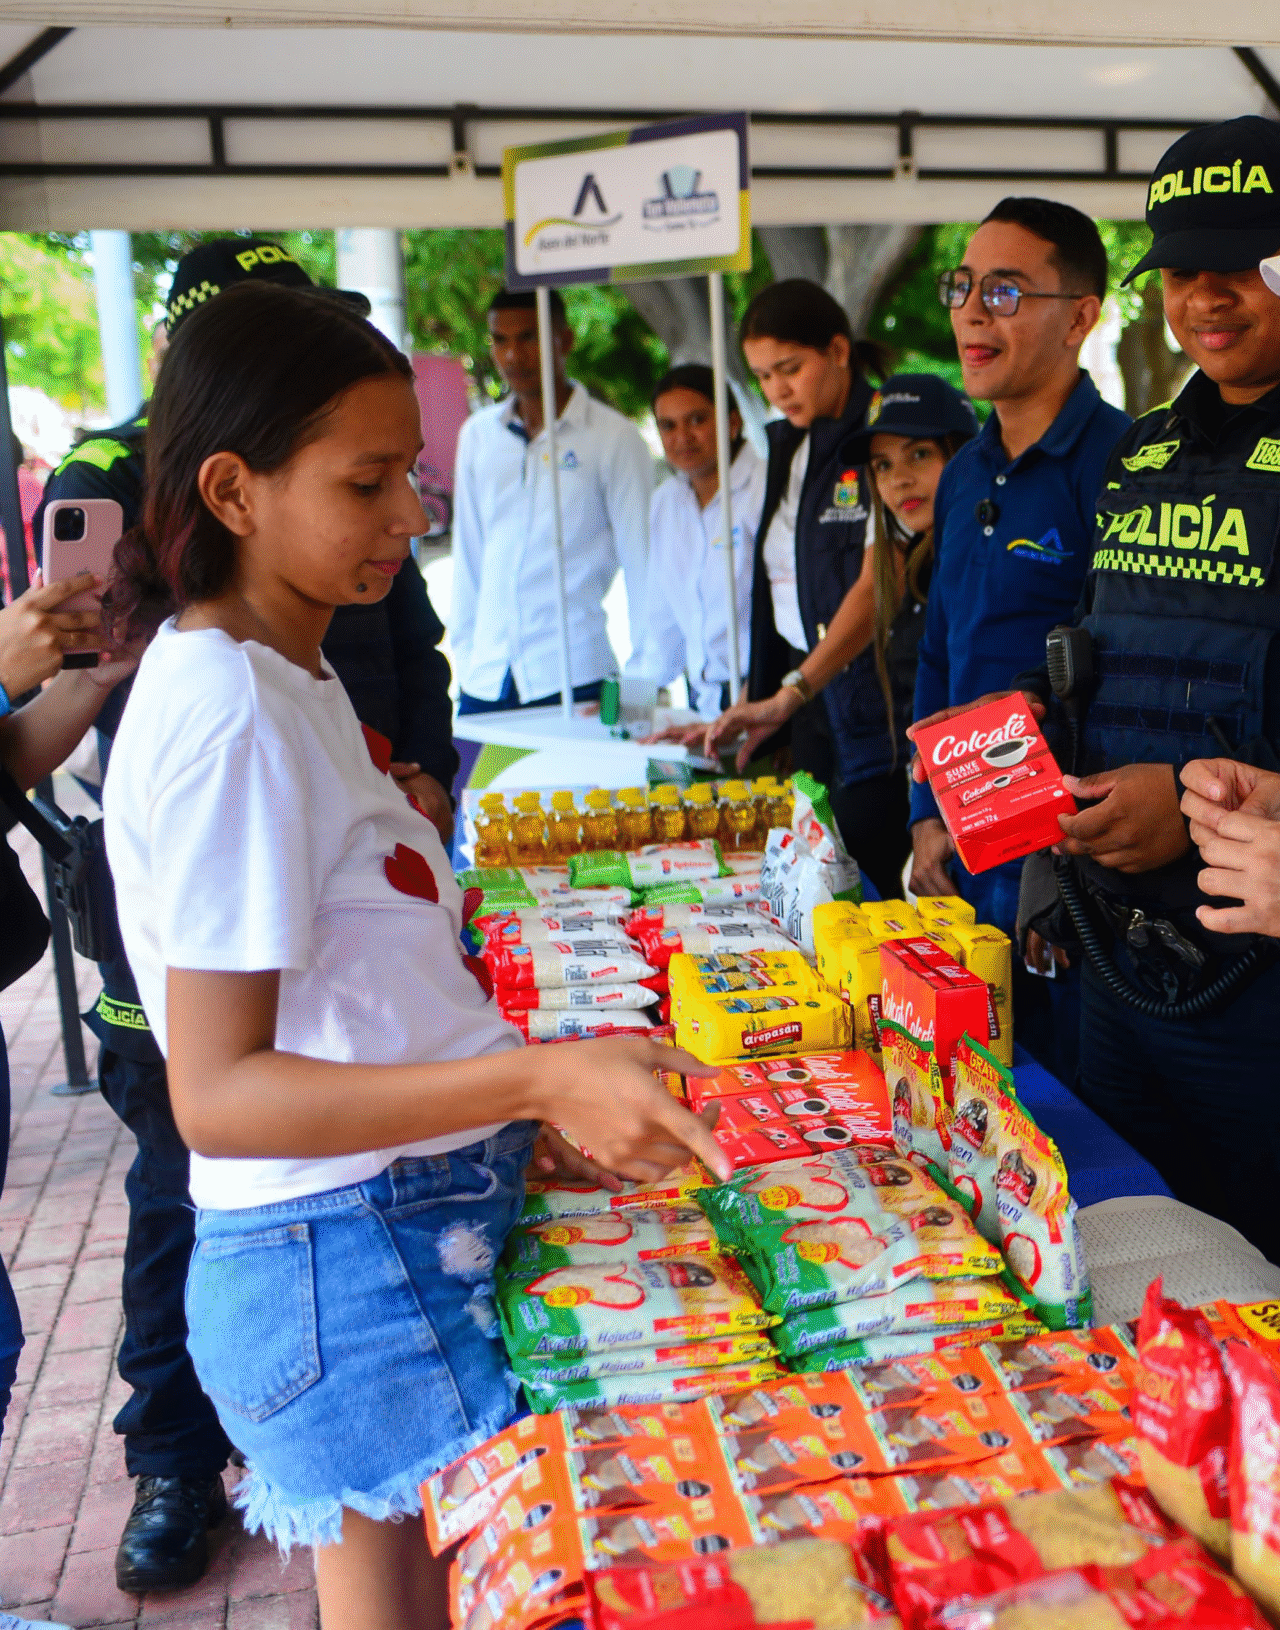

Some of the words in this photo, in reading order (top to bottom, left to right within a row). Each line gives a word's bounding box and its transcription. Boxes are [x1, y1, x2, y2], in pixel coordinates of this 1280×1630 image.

[1147, 159, 1274, 211] POLICÍA
[1102, 494, 1250, 556] POLICÍA
[932, 713, 1026, 766] Colcafé
[945, 760, 979, 777] SUAVE
[784, 1289, 837, 1308] Avena
[535, 1332, 588, 1352] Avena
[597, 1330, 643, 1345] Hojuela
[797, 1327, 847, 1350] Avena
[535, 1363, 590, 1380] Avena
[599, 1359, 644, 1373] Hojuela
[617, 1390, 662, 1405] Hojuela
